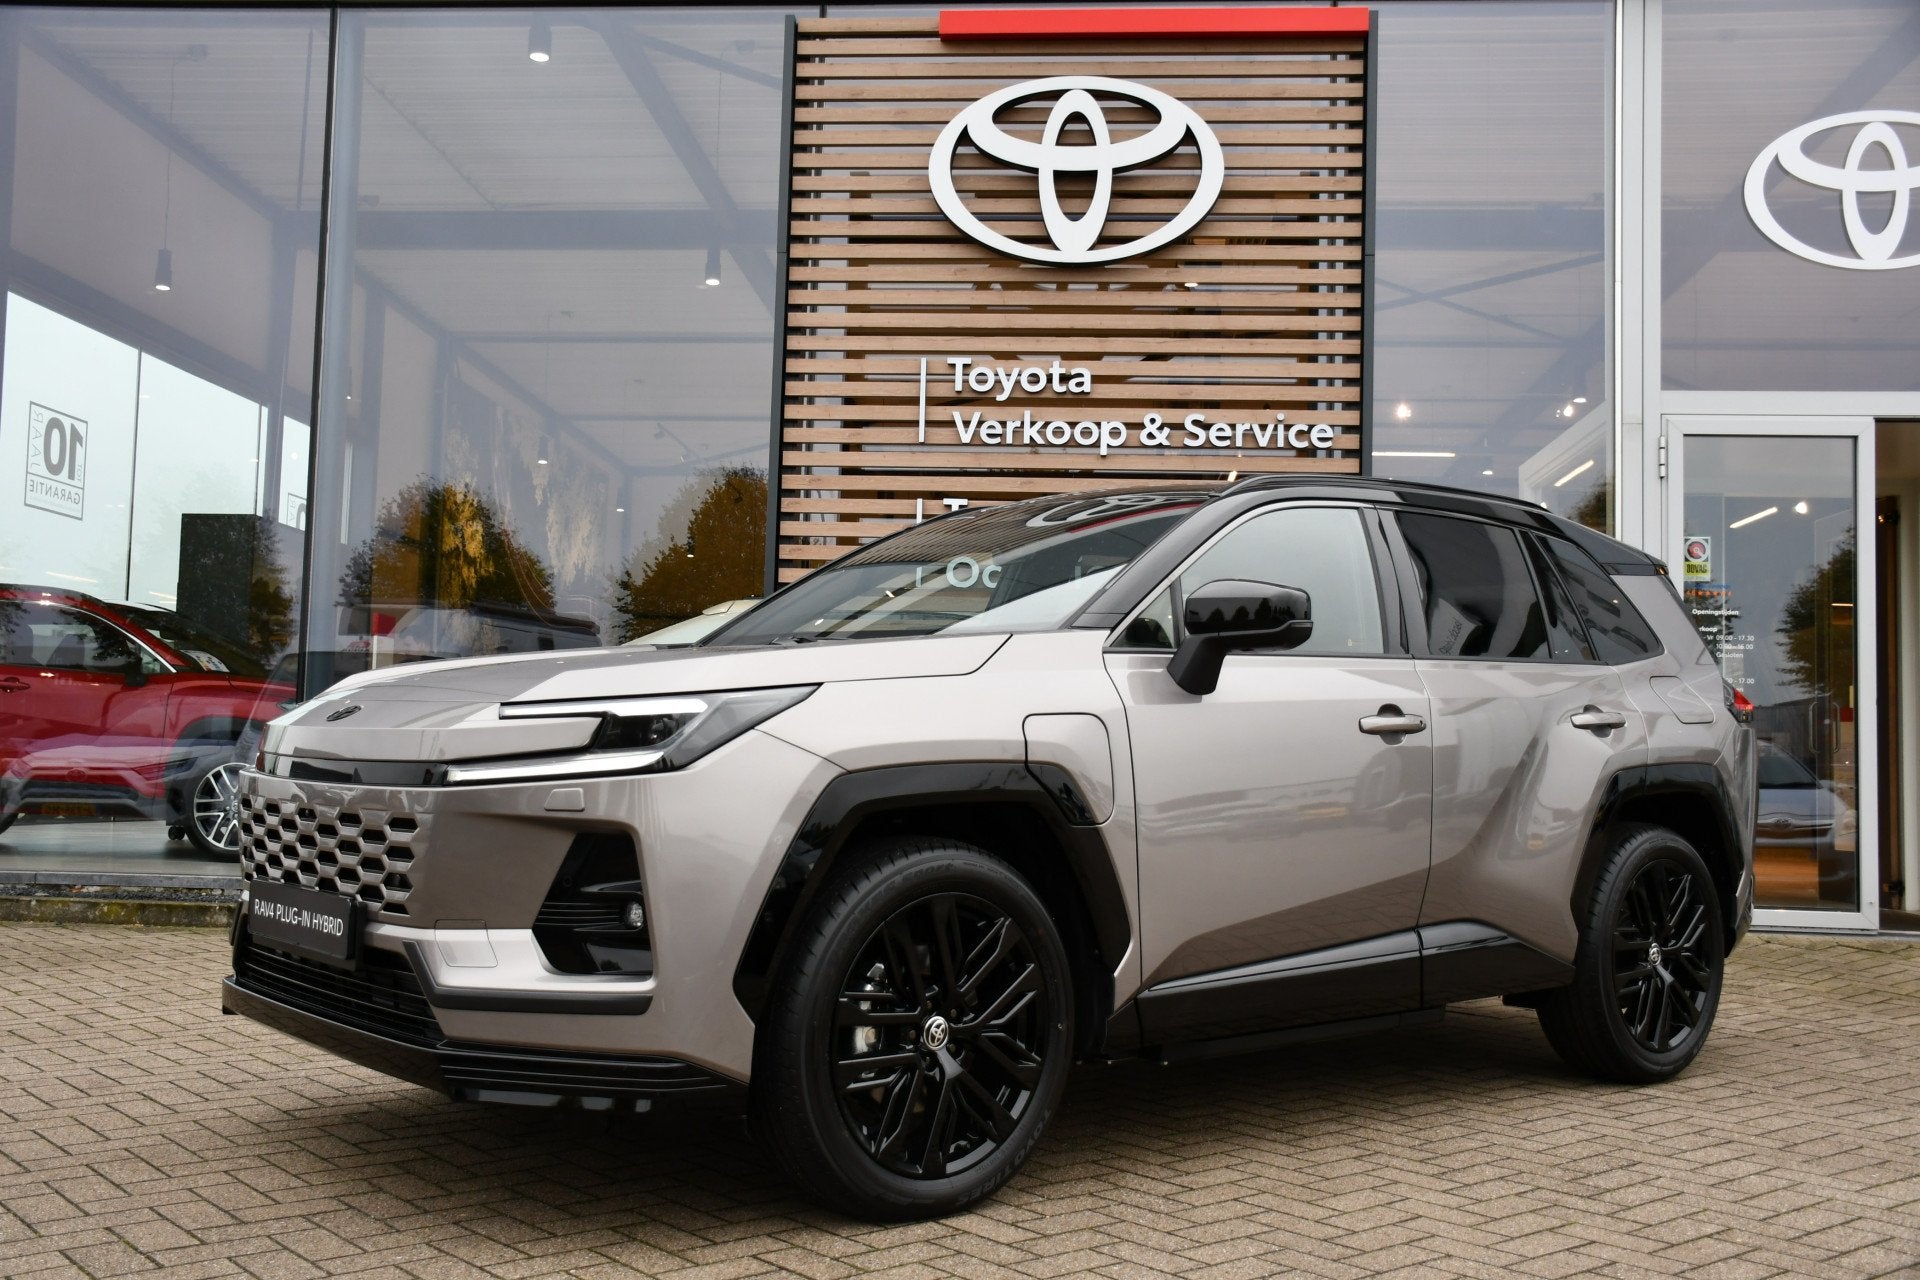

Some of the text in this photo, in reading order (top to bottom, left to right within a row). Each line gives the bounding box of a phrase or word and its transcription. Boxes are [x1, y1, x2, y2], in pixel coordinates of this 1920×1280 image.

[947, 357, 1092, 401] Toyota
[952, 410, 1334, 456] Verkoop & Service
[254, 898, 344, 937] RAV4 PLUG-IN HYBRID
